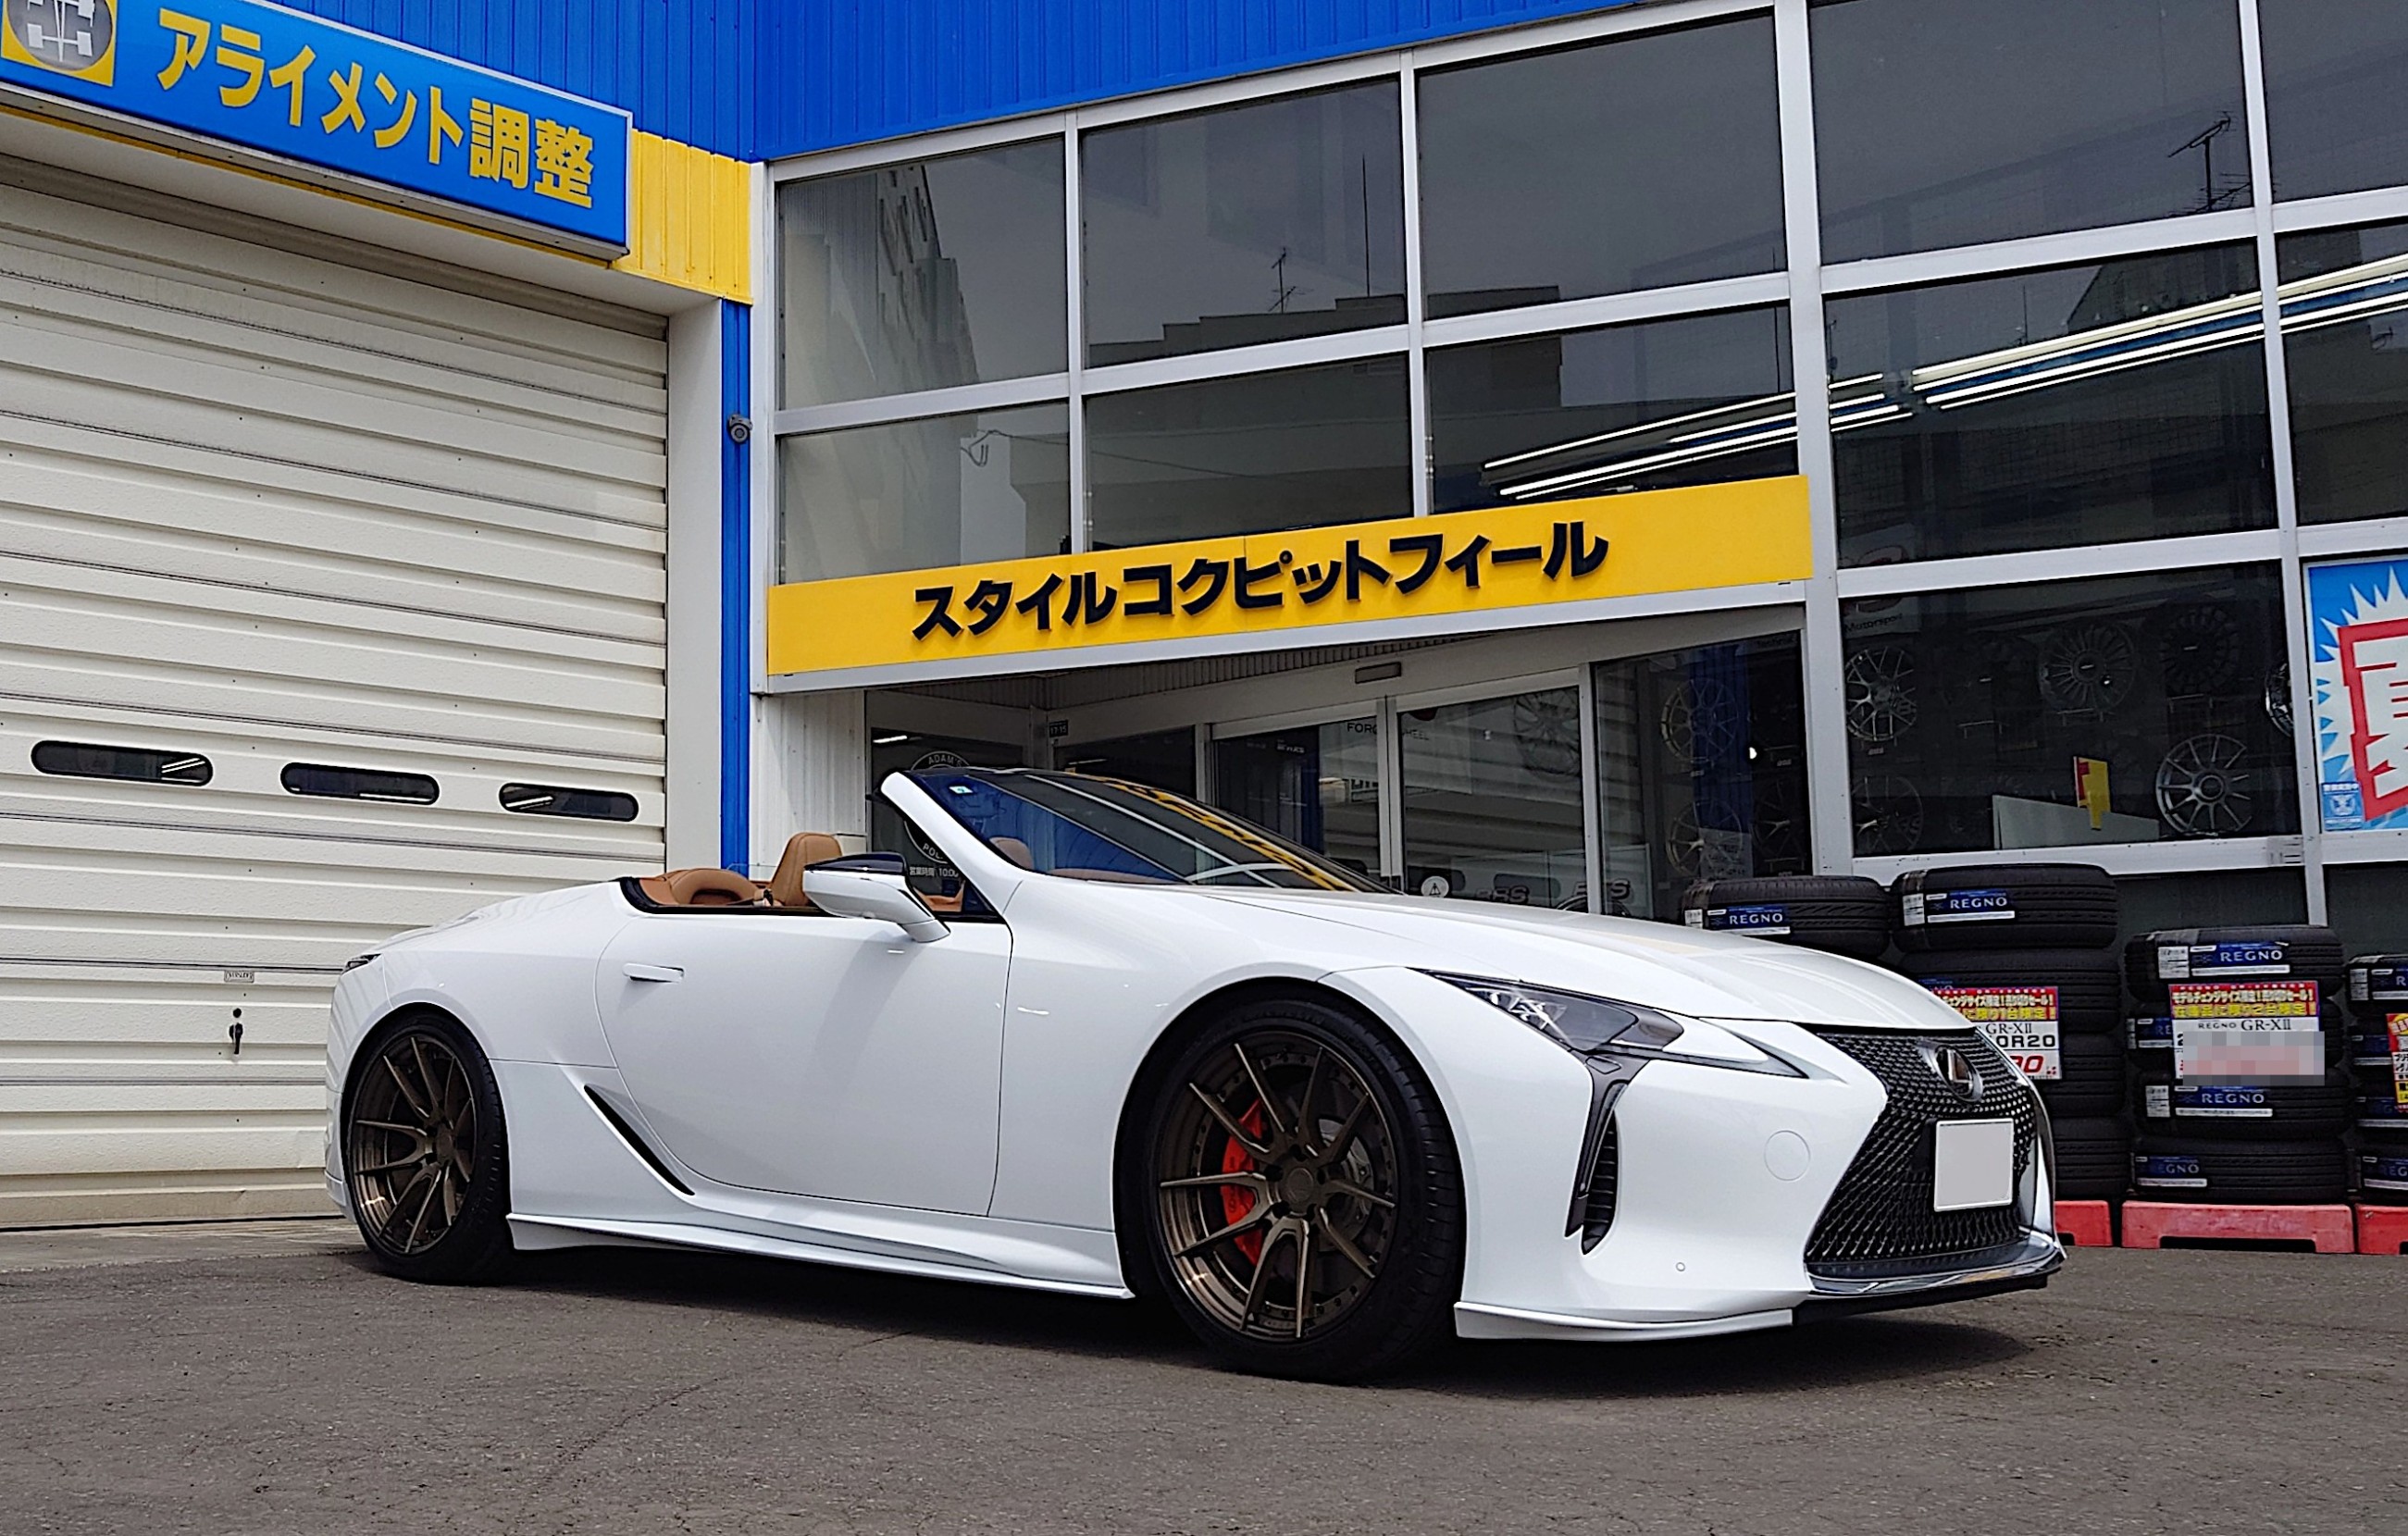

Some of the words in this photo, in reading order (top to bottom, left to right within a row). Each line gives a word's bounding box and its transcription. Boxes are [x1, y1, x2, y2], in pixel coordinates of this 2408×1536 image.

[156, 7, 596, 209] アライメント調整
[911, 521, 1611, 642] スタイルコクピットフィール
[1950, 896, 2007, 910] REGNO
[1729, 911, 1783, 925] REGNO
[2220, 949, 2283, 962] REGNO
[2198, 1022, 2238, 1030] REGNO
[1994, 1034, 2055, 1047] 0R20
[2201, 1093, 2265, 1104] REGNO
[2157, 1163, 2200, 1174] EGNO
